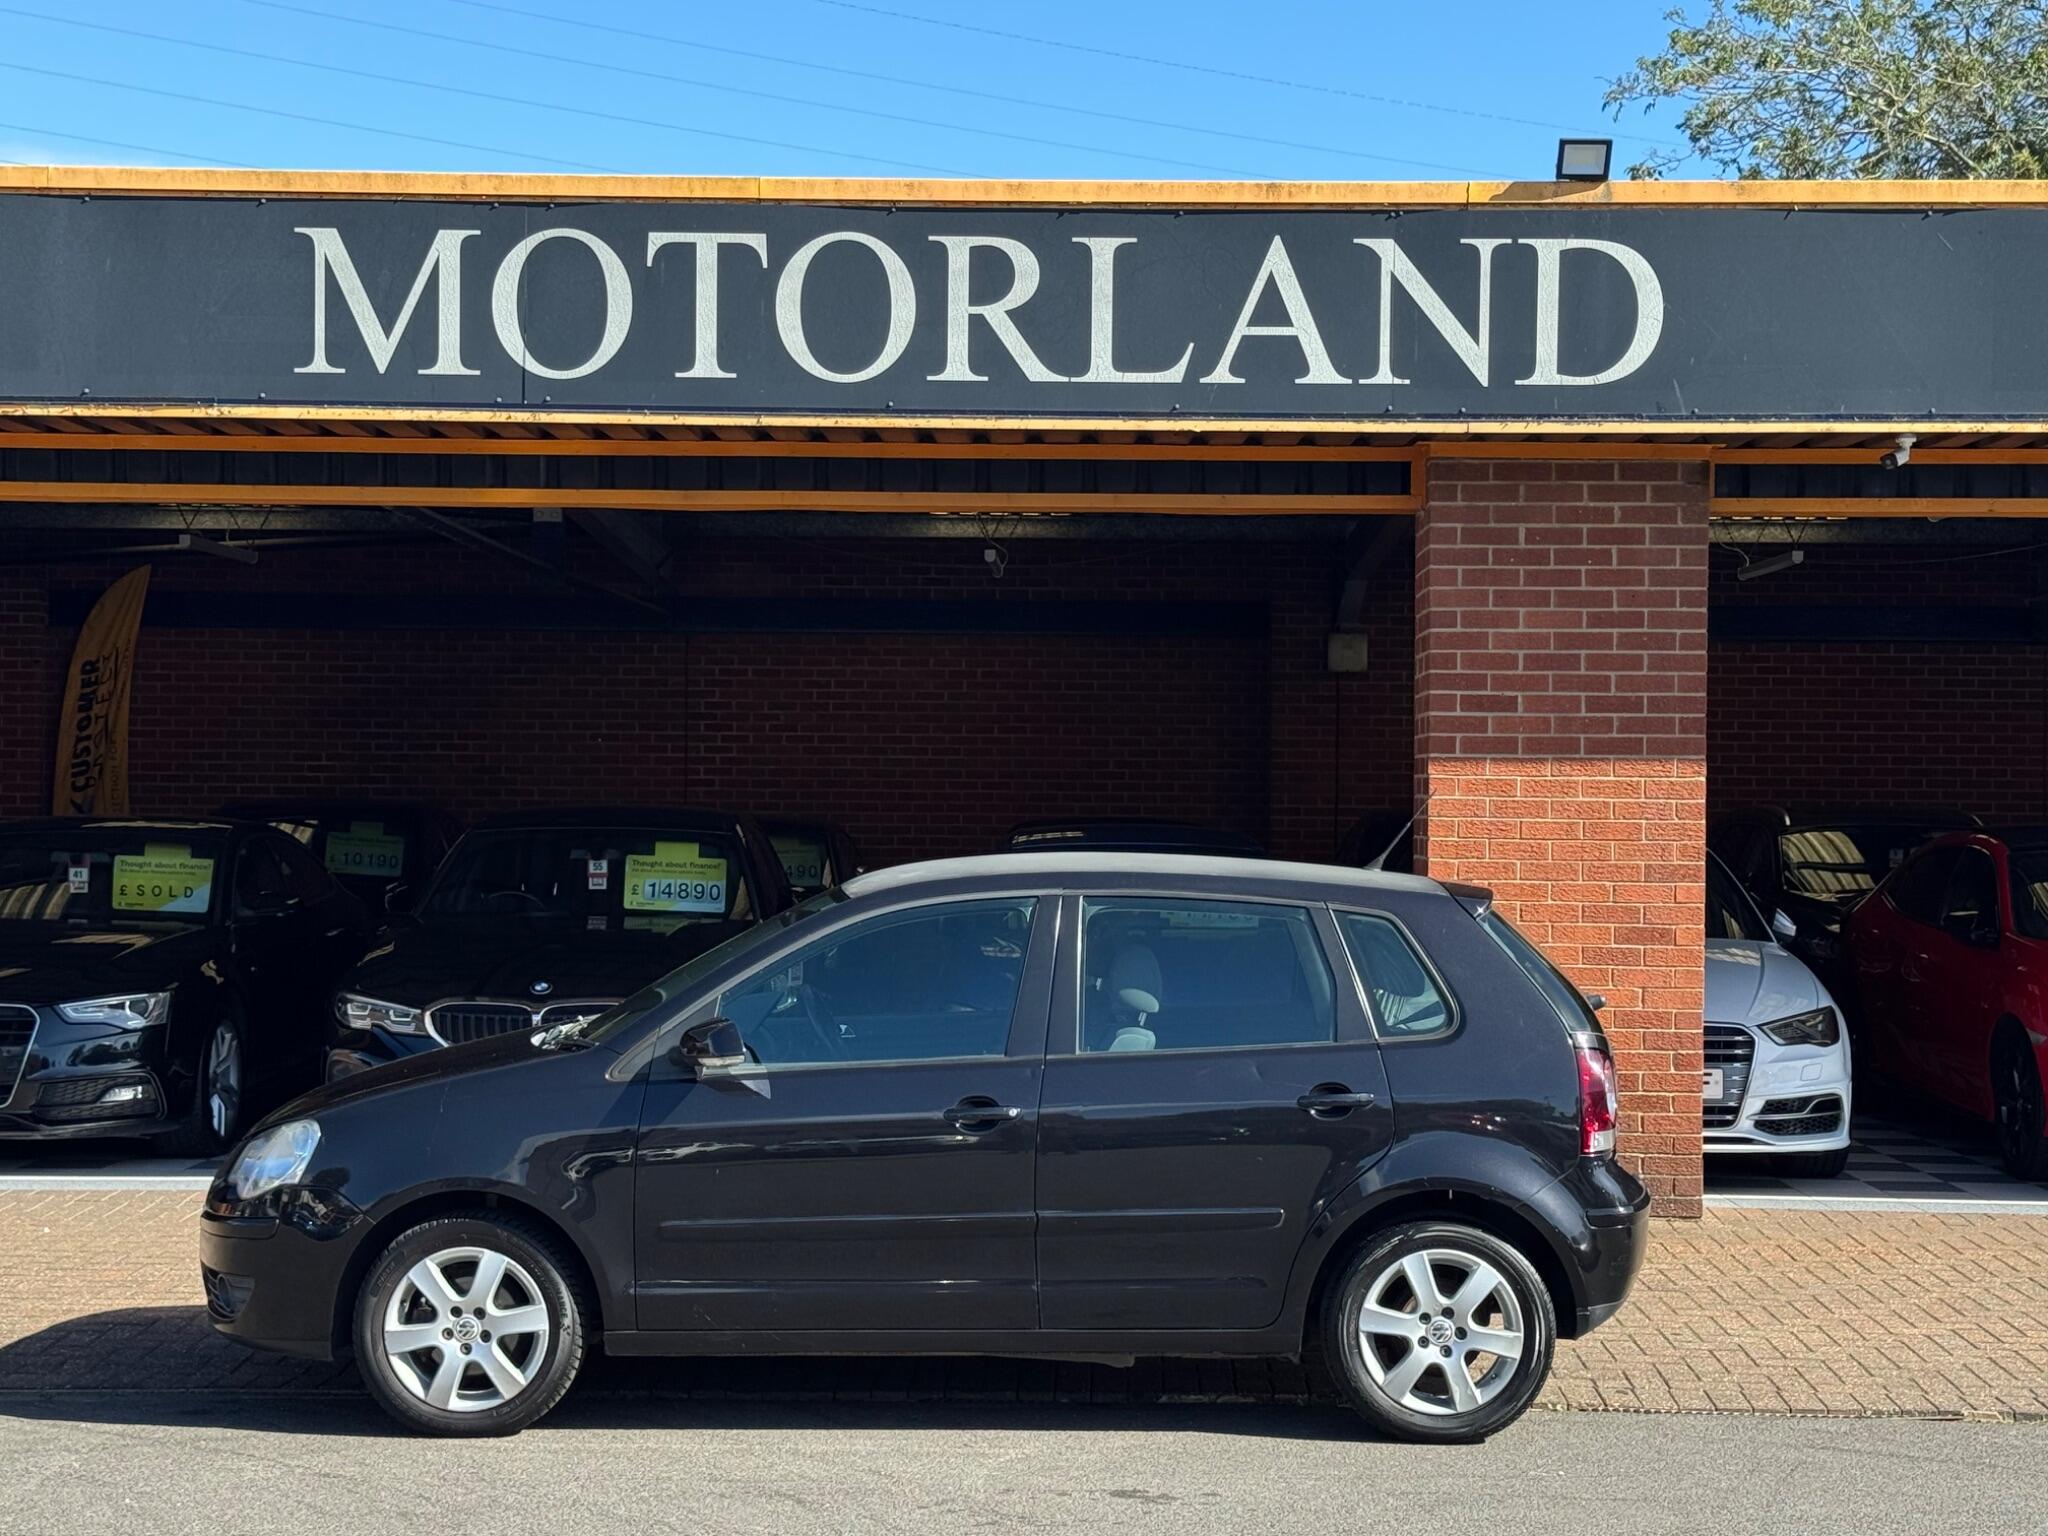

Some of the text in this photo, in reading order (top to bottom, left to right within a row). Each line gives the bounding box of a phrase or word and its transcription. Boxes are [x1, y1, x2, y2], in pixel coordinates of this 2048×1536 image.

[293, 227, 1664, 388] MOTORLAND
[71, 658, 100, 792] CUSTOMER
[120, 860, 152, 869] Thought
[154, 861, 177, 869] about
[632, 859, 663, 868] Thought
[648, 882, 721, 901] 14890
